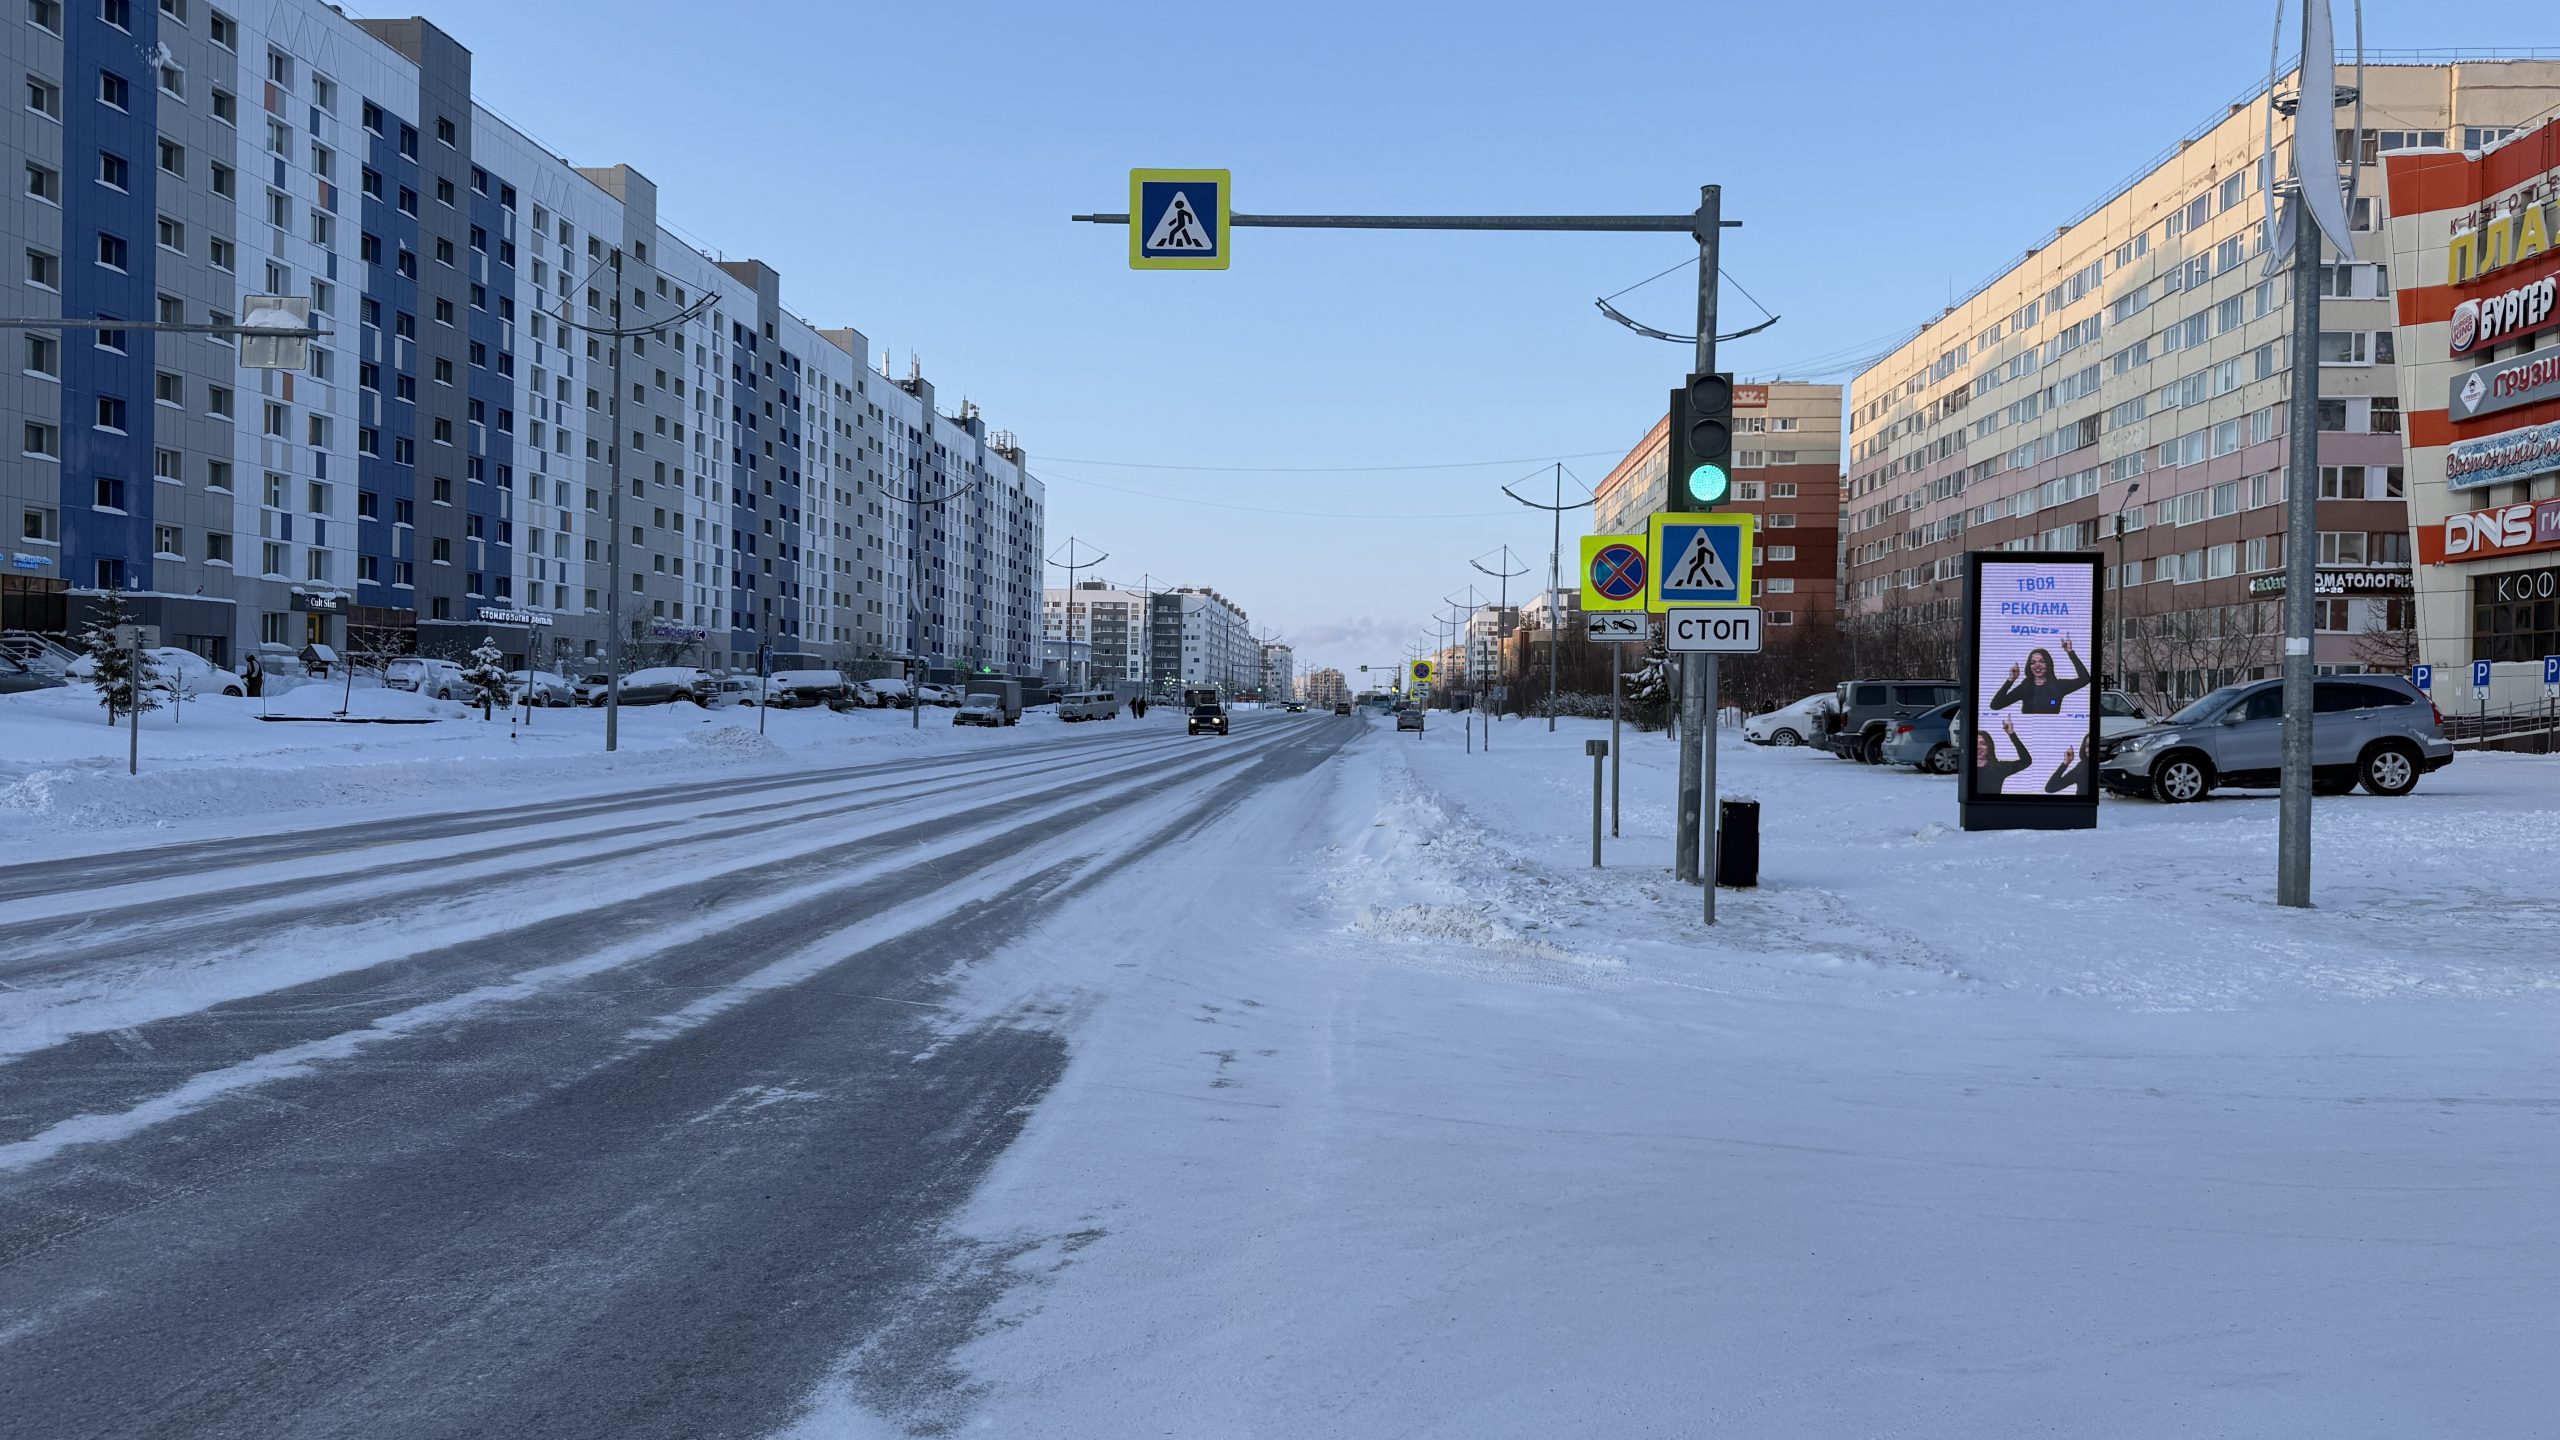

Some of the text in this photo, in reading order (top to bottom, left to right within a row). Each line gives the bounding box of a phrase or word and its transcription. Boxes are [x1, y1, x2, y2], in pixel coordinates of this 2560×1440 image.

[2480, 278, 2557, 341] БУРГЕР
[2446, 430, 2542, 479] Восточный
[2444, 505, 2534, 555] DNS
[2016, 577, 2055, 592] ТВОЯ
[2498, 571, 2554, 602] КОФ
[310, 597, 337, 609] Cult Slim
[2001, 602, 2069, 615] РЕКЛАМА
[481, 610, 530, 623] СТОМАТОЛОГИЯ
[1677, 619, 1750, 640] СТОП
